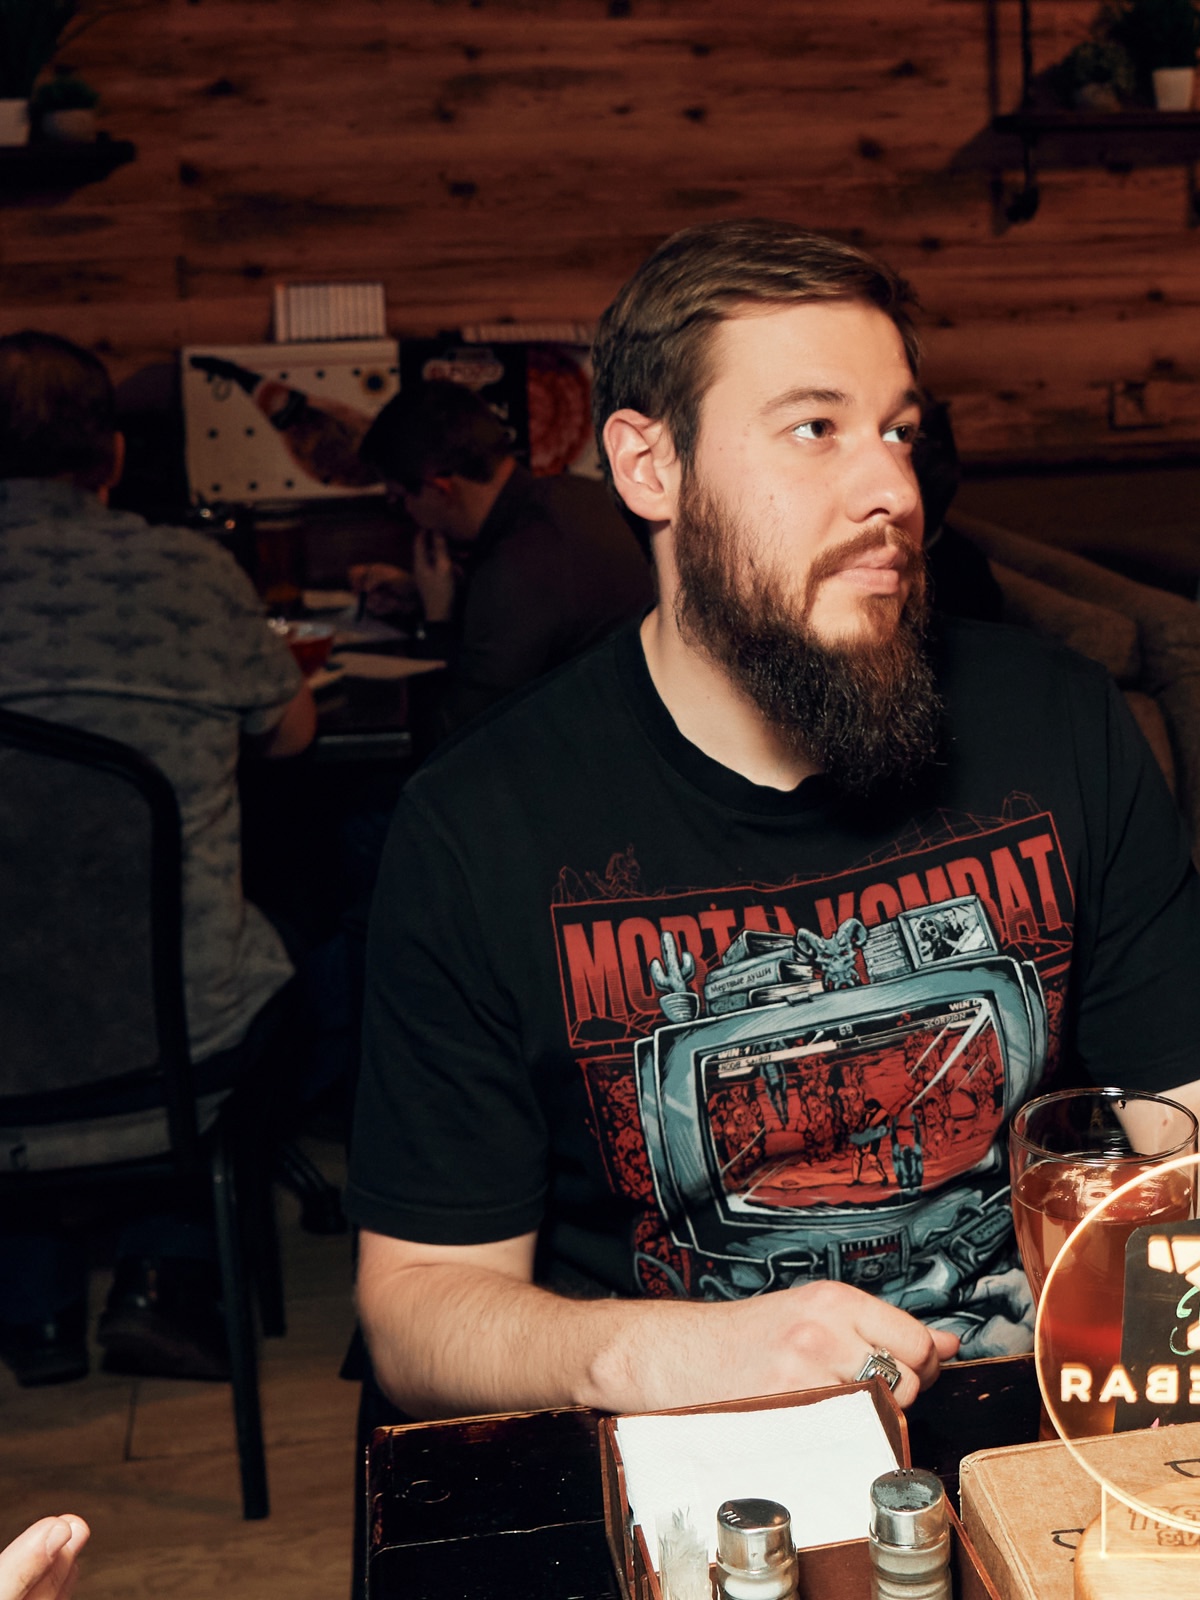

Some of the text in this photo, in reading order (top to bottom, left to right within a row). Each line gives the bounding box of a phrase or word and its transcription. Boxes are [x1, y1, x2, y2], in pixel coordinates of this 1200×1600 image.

[747, 966, 772, 983] души
[924, 1012, 966, 1029] SCORPION
[838, 1024, 853, 1036] 69
